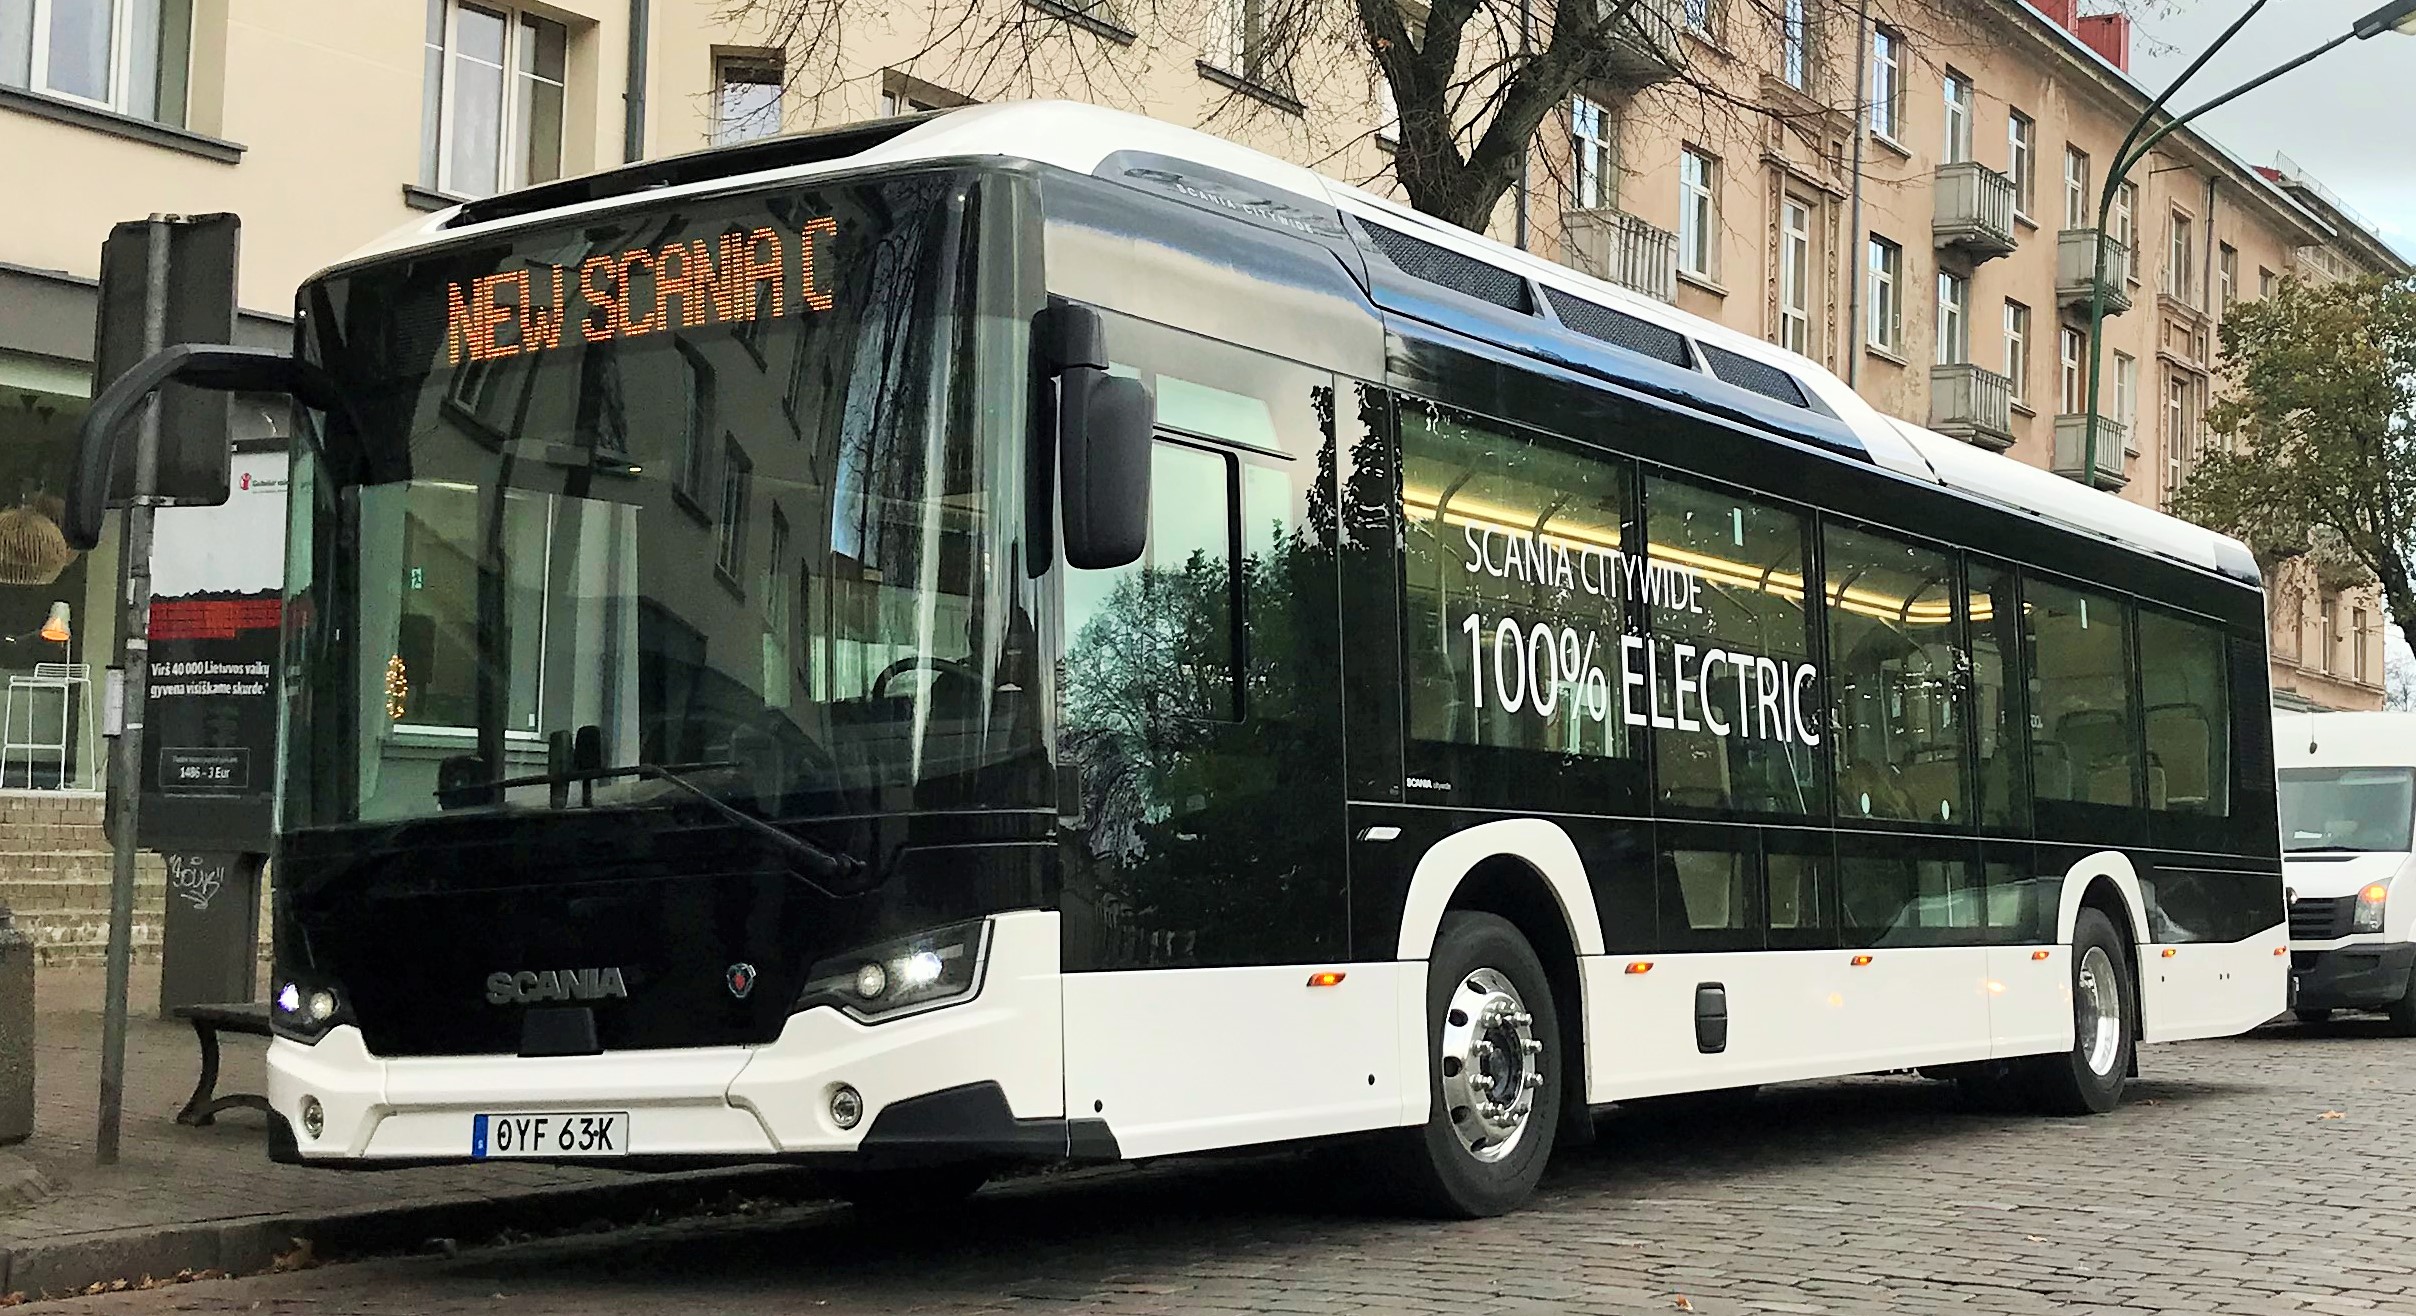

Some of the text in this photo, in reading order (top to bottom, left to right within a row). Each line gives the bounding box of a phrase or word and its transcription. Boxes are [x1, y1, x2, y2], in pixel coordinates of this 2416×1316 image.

[1176, 183, 1314, 234] SCANIA CITYWIDE
[447, 216, 838, 366] NEW SCANIA C
[1465, 520, 1703, 615] SCANIA CITYWIDE
[151, 662, 170, 676] Virš
[172, 662, 184, 676] 40
[186, 662, 203, 675] 000
[204, 660, 243, 675] Lietuvos
[1462, 612, 1820, 747] 100% ELECTRIC
[150, 684, 185, 699] gyvena
[186, 681, 231, 694] visiškame
[215, 766, 230, 778] Eur
[486, 967, 628, 1005] SCANIA
[497, 1117, 614, 1151] OYF 63K
